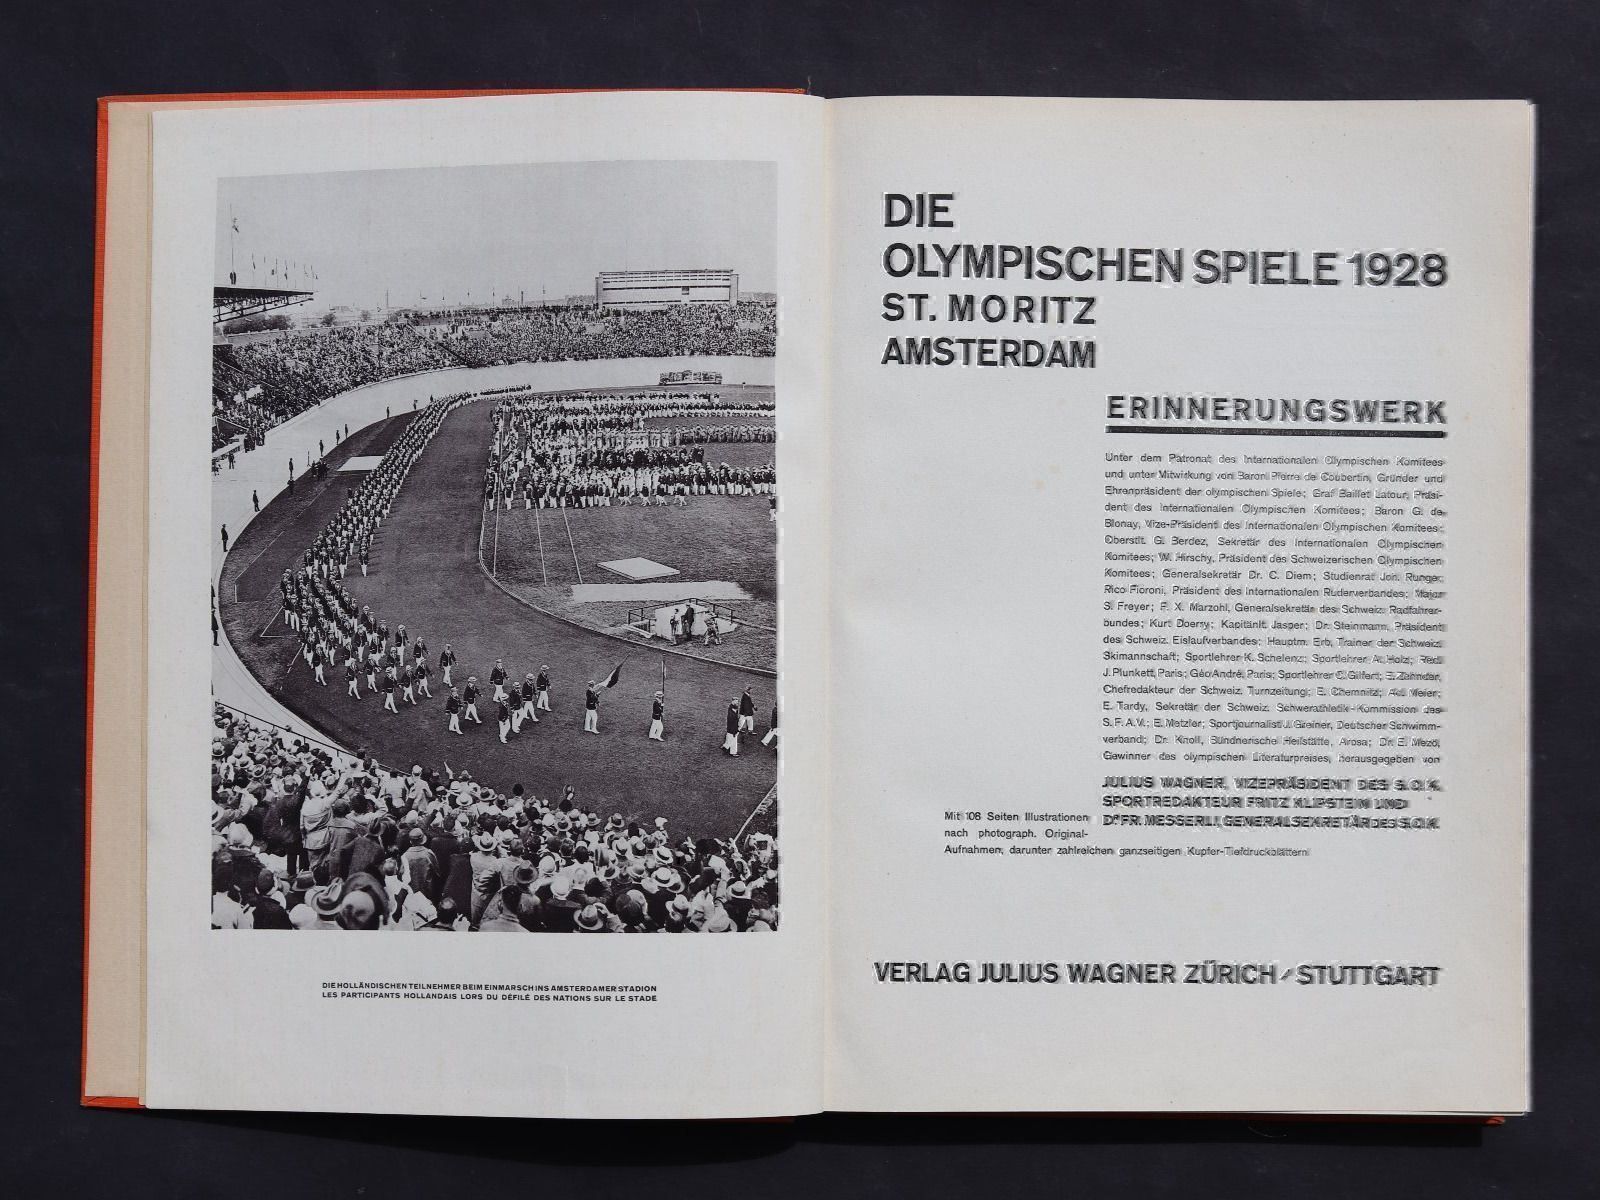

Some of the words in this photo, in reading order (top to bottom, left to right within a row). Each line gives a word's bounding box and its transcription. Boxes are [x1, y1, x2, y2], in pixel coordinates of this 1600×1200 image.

[884, 193, 954, 228] DIE
[882, 242, 1181, 283] OLYMPISCHEN
[1191, 248, 1340, 286] SPIELE
[1346, 251, 1443, 287] 1928
[881, 292, 938, 321] ST.
[948, 294, 1096, 325] MORITZ
[881, 337, 1096, 369] AMSTERDAM
[1106, 395, 1444, 424] ERINNERUNGSWERK
[1105, 452, 1133, 462] Unter
[1140, 453, 1162, 463] dem
[1169, 453, 1212, 464] Patronat
[1218, 454, 1236, 464] des
[1105, 469, 1124, 479] und
[1129, 469, 1154, 480] unter
[1216, 473, 1234, 481] von
[1424, 473, 1444, 483] und
[1105, 485, 1181, 498] Ehrenpräsident
[1185, 486, 1201, 496] der
[1205, 486, 1267, 499] olympischen
[1104, 502, 1127, 512] dent
[1134, 502, 1152, 512] des
[1160, 502, 1234, 513] Internationalen
[1223, 520, 1240, 530] des
[1268, 537, 1286, 547] des
[1295, 537, 1368, 548] Internationalen
[1219, 552, 1266, 563] Präsident
[1270, 553, 1287, 563] des
[1290, 553, 1373, 564] Schweizerischen
[1162, 569, 1242, 580] Generalsekretär
[1248, 570, 1263, 580] Dr.
[1286, 570, 1316, 582] Diem;
[1172, 585, 1220, 596] Präsident
[1224, 586, 1242, 596] des
[1174, 602, 1184, 612] X.
[1319, 603, 1337, 614] des
[1104, 618, 1144, 629] bundes;
[1103, 634, 1121, 644] des
[1125, 634, 1169, 645] Schweiz.
[1103, 651, 1180, 663] Skimannschaft;
[1103, 684, 1174, 695] Chefredakteur
[1179, 685, 1196, 695] der
[1200, 685, 1243, 696] Schweiz.
[1155, 701, 1198, 712] Sekretär
[1204, 702, 1221, 712] der
[1183, 751, 1245, 764] olympischen
[944, 811, 960, 821] Mit
[987, 811, 1019, 822] Seiten
[1025, 812, 1089, 822] Illustrationen
[944, 828, 968, 838] nach
[978, 828, 1037, 841] photograph.
[1045, 828, 1088, 841] Original-
[1009, 845, 1052, 855] darunter
[1056, 845, 1114, 856] zahlreichen
[1119, 846, 1181, 858] ganzseitigen
[873, 962, 970, 983] VERLAG
[977, 962, 1058, 983] JULIUS
[1066, 962, 1176, 984] WAGNER
[1182, 959, 1277, 985] ZÜRICH
[1295, 964, 1441, 986] STUTTGART
[337, 982, 407, 990] HOLLÄNDISCHEN
[462, 983, 483, 991] BEIM
[551, 984, 617, 992] AMSTERDAMER
[341, 991, 401, 999] PARTICIPANTS
[403, 992, 457, 1000] HOLLANDAIS
[533, 993, 551, 1001] DES
[628, 994, 658, 1002] STADE
